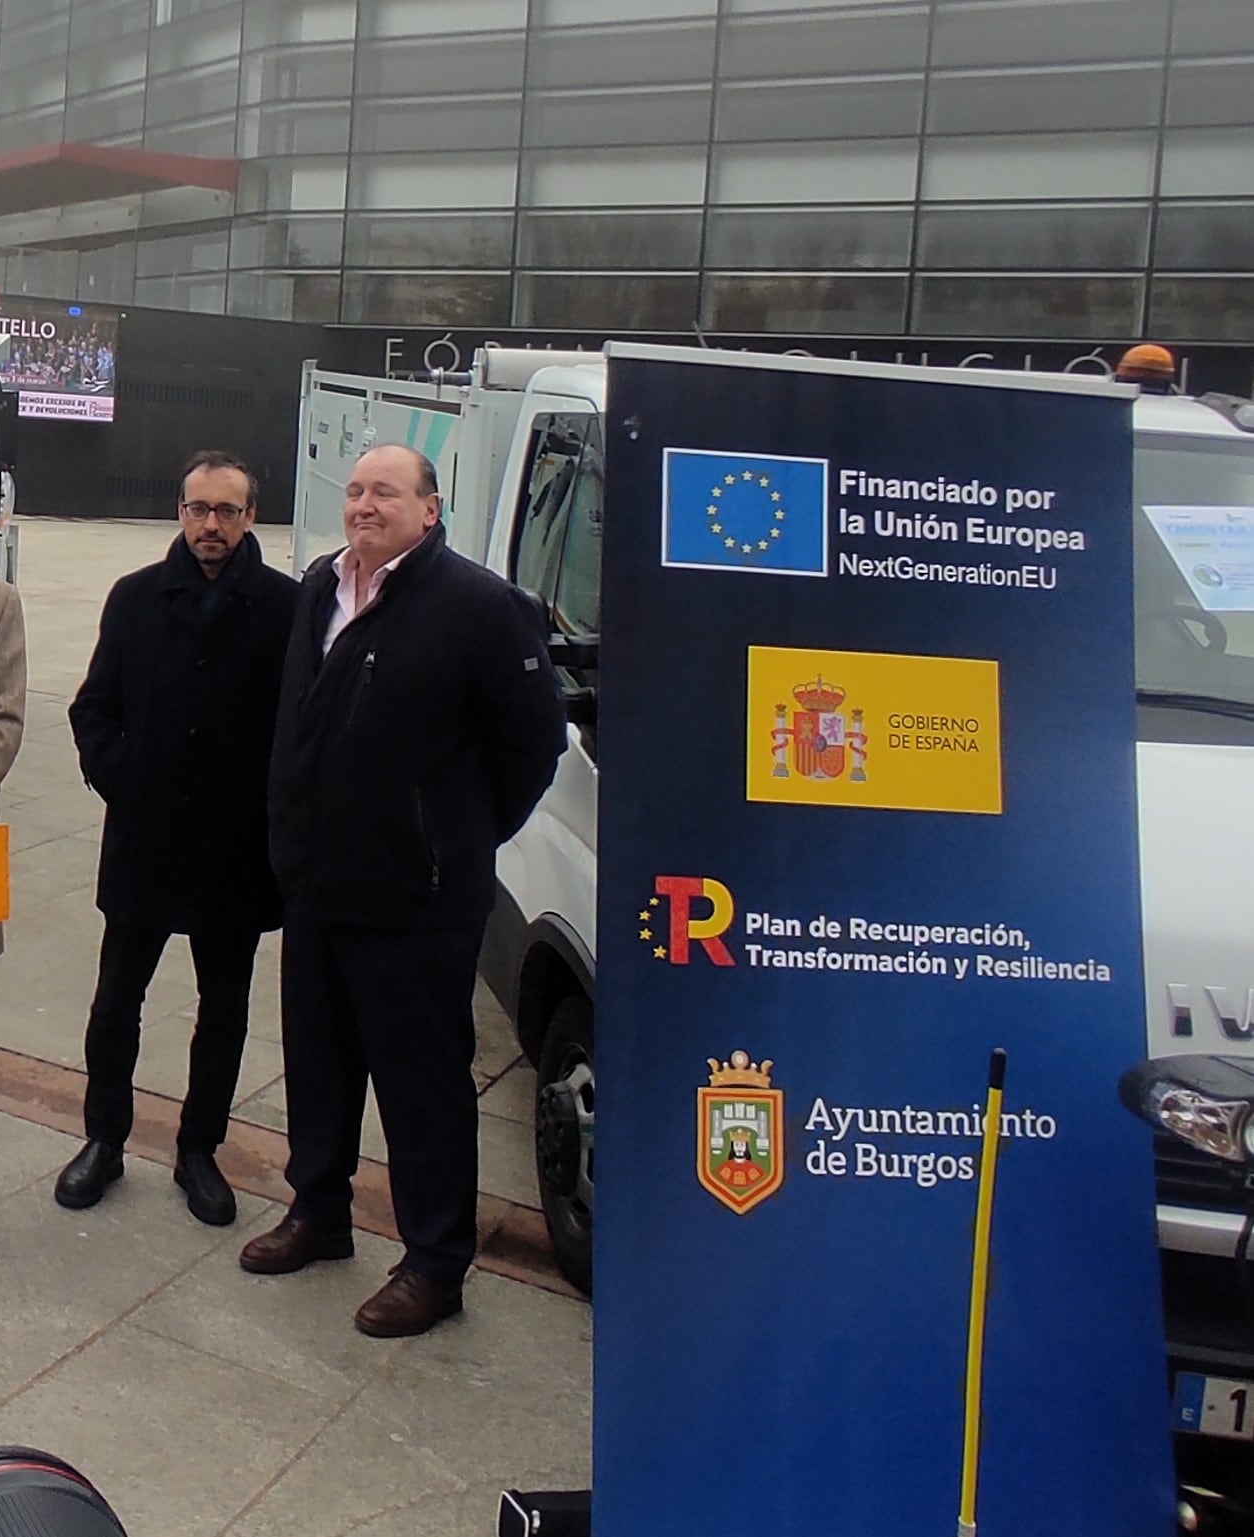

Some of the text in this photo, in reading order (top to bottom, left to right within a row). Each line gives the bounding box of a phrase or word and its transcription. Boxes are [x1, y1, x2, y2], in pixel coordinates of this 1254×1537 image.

[839, 469, 1055, 513] Financiado por
[839, 508, 1085, 553] la Unión Europea
[839, 552, 1057, 590] NextGenerationEU
[888, 713, 979, 733] GOBIERNO
[889, 733, 980, 752] DE ESPAÑA
[746, 912, 1030, 951] Plan de Recuperación,
[745, 944, 1111, 982] Transformación y Resiliencia
[804, 1097, 1057, 1140] Ayuntaminto
[805, 1140, 975, 1188] de Burgos
[1181, 1407, 1195, 1421] E
